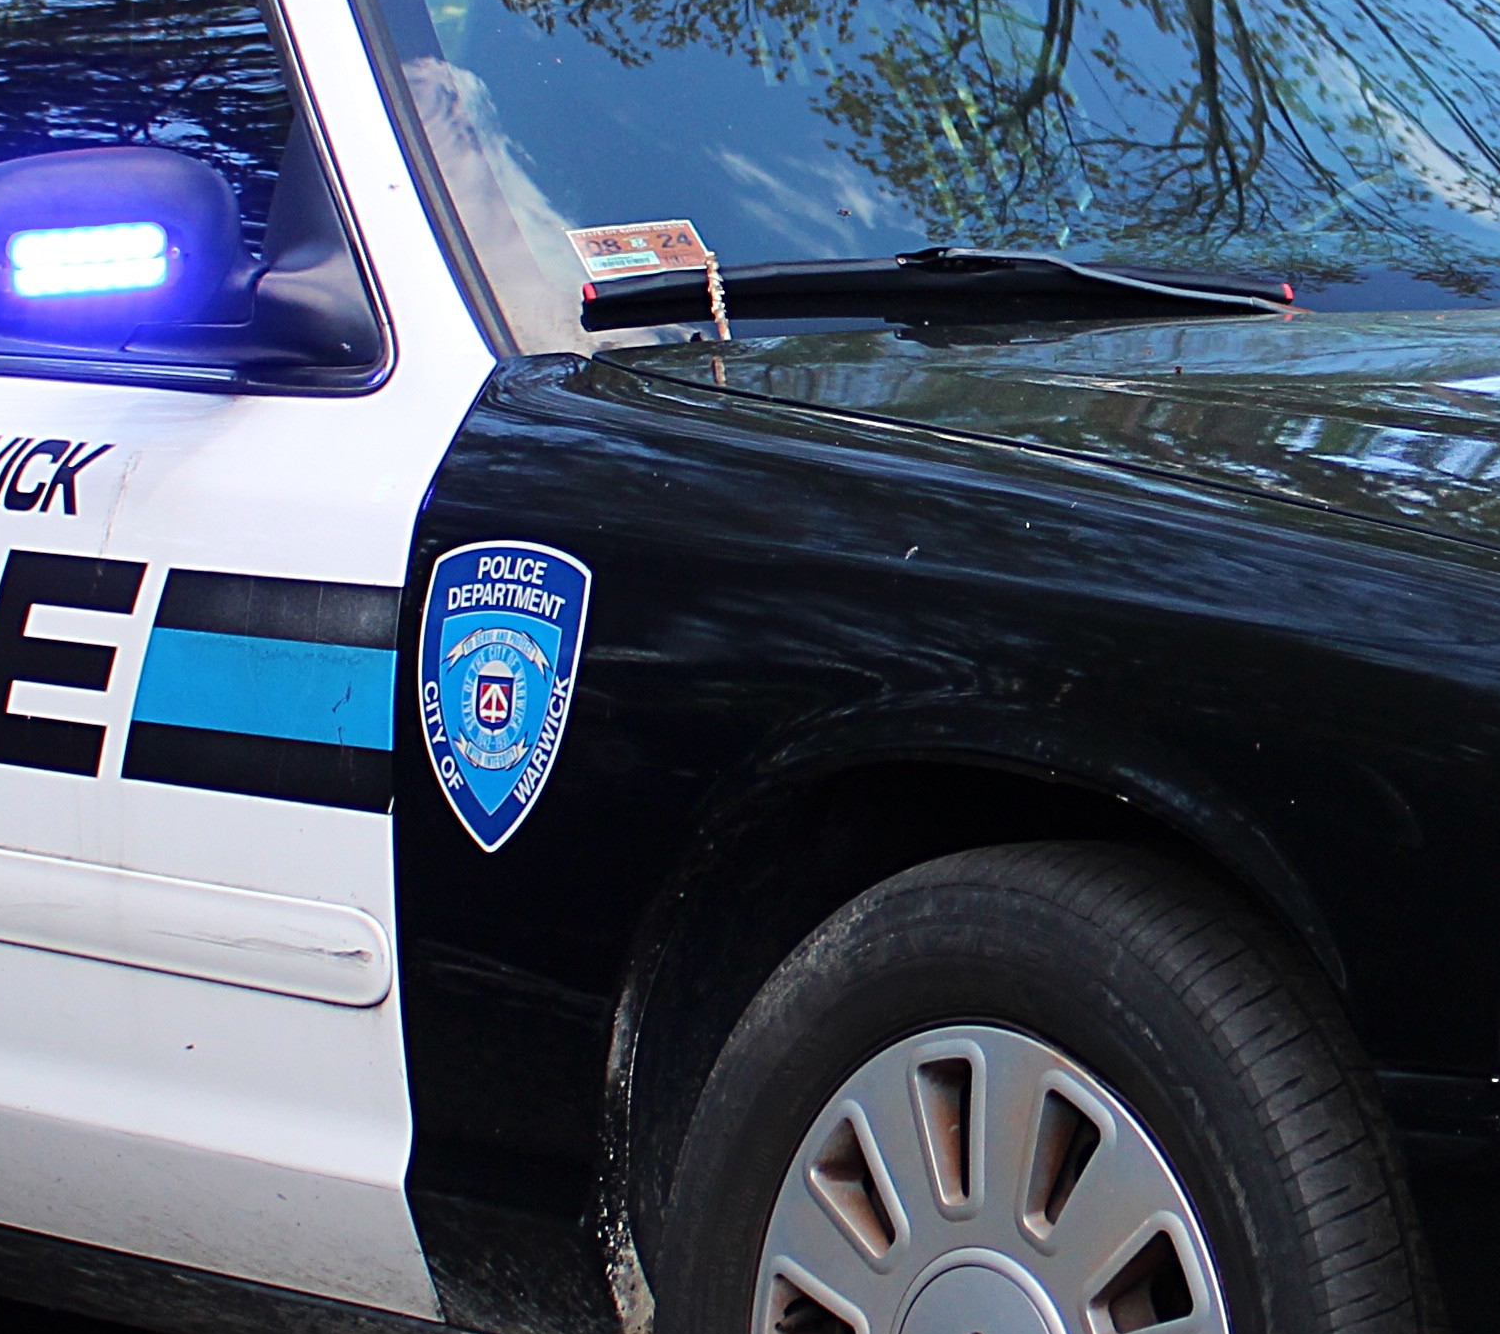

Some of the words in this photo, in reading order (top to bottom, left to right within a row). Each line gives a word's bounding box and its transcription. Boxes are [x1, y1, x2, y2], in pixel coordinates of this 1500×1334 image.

[477, 555, 548, 585] POLICE
[447, 583, 566, 620] DEPARTMENT
[424, 680, 447, 745] CITY
[441, 755, 465, 791] OF
[513, 676, 570, 804] WARWICK
